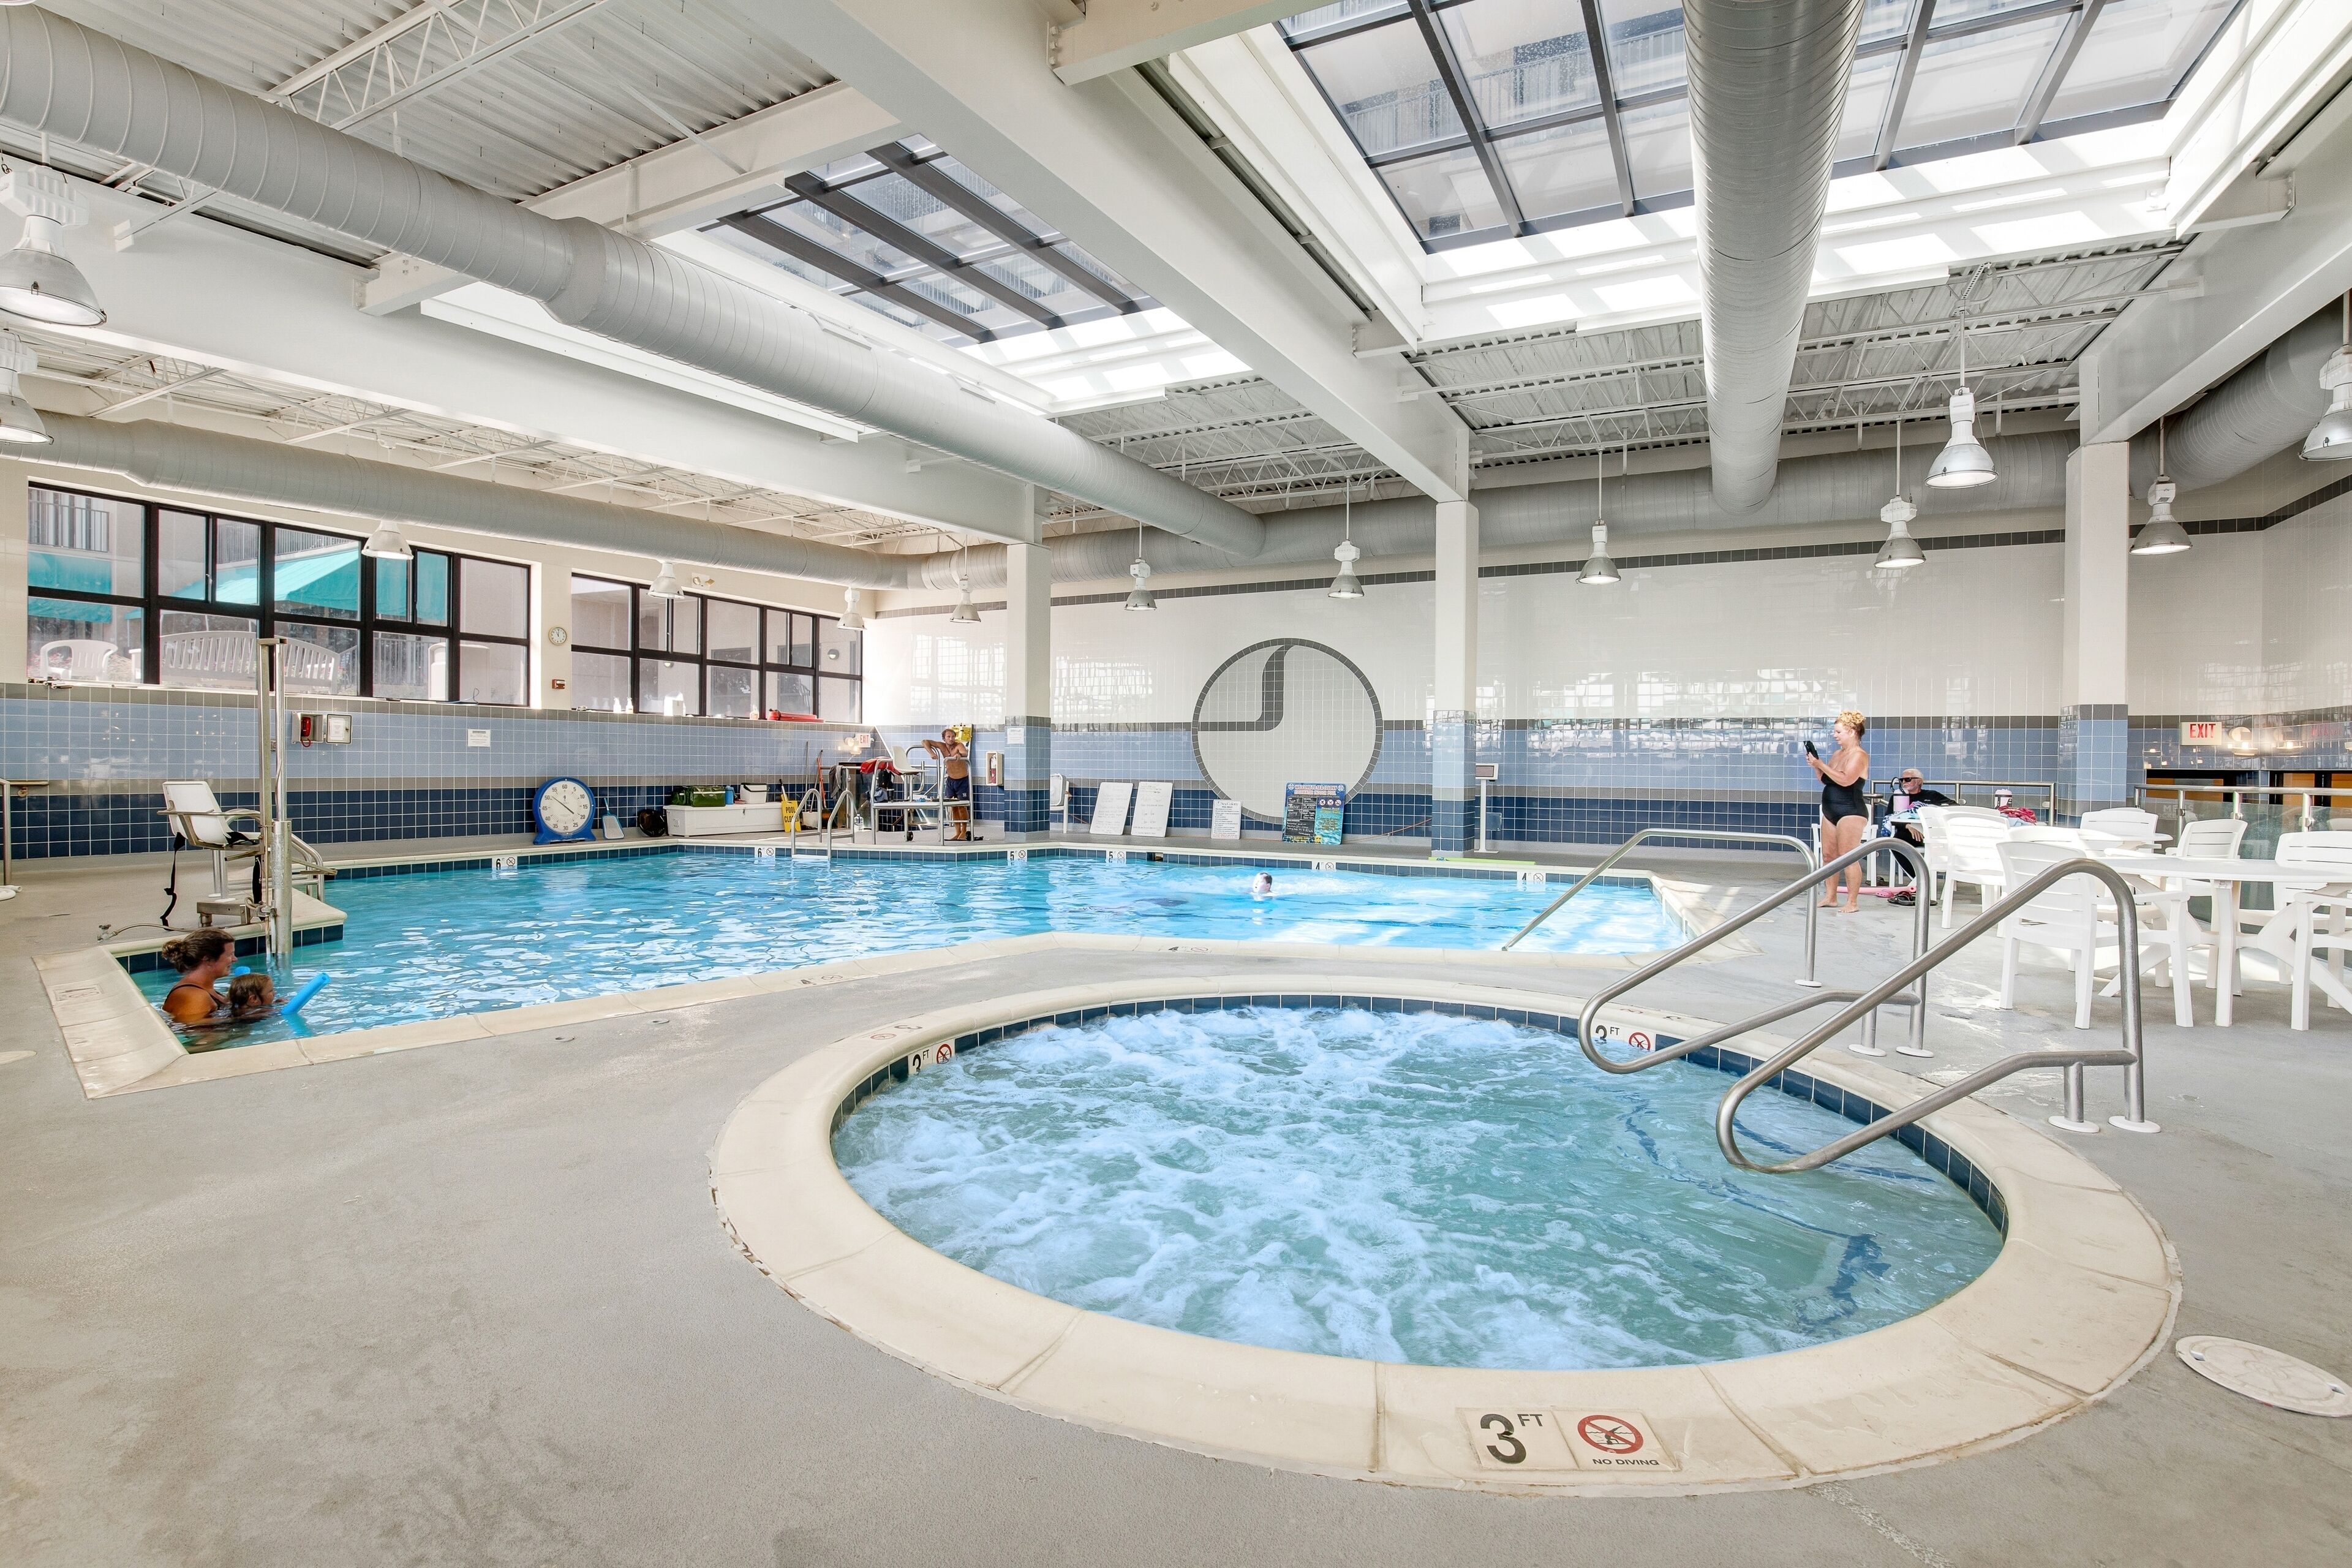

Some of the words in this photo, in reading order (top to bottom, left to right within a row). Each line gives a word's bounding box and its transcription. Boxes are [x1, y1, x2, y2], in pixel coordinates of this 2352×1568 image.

[2190, 723, 2216, 738] EXIT
[860, 734, 869, 744] EXIT
[758, 847, 763, 858] 6
[1010, 851, 1014, 861] 5
[496, 858, 501, 870] 6
[1610, 1027, 1620, 1035] FT
[922, 1049, 930, 1060] FT
[1480, 1414, 1526, 1464] 3
[1517, 1413, 1544, 1427] FT
